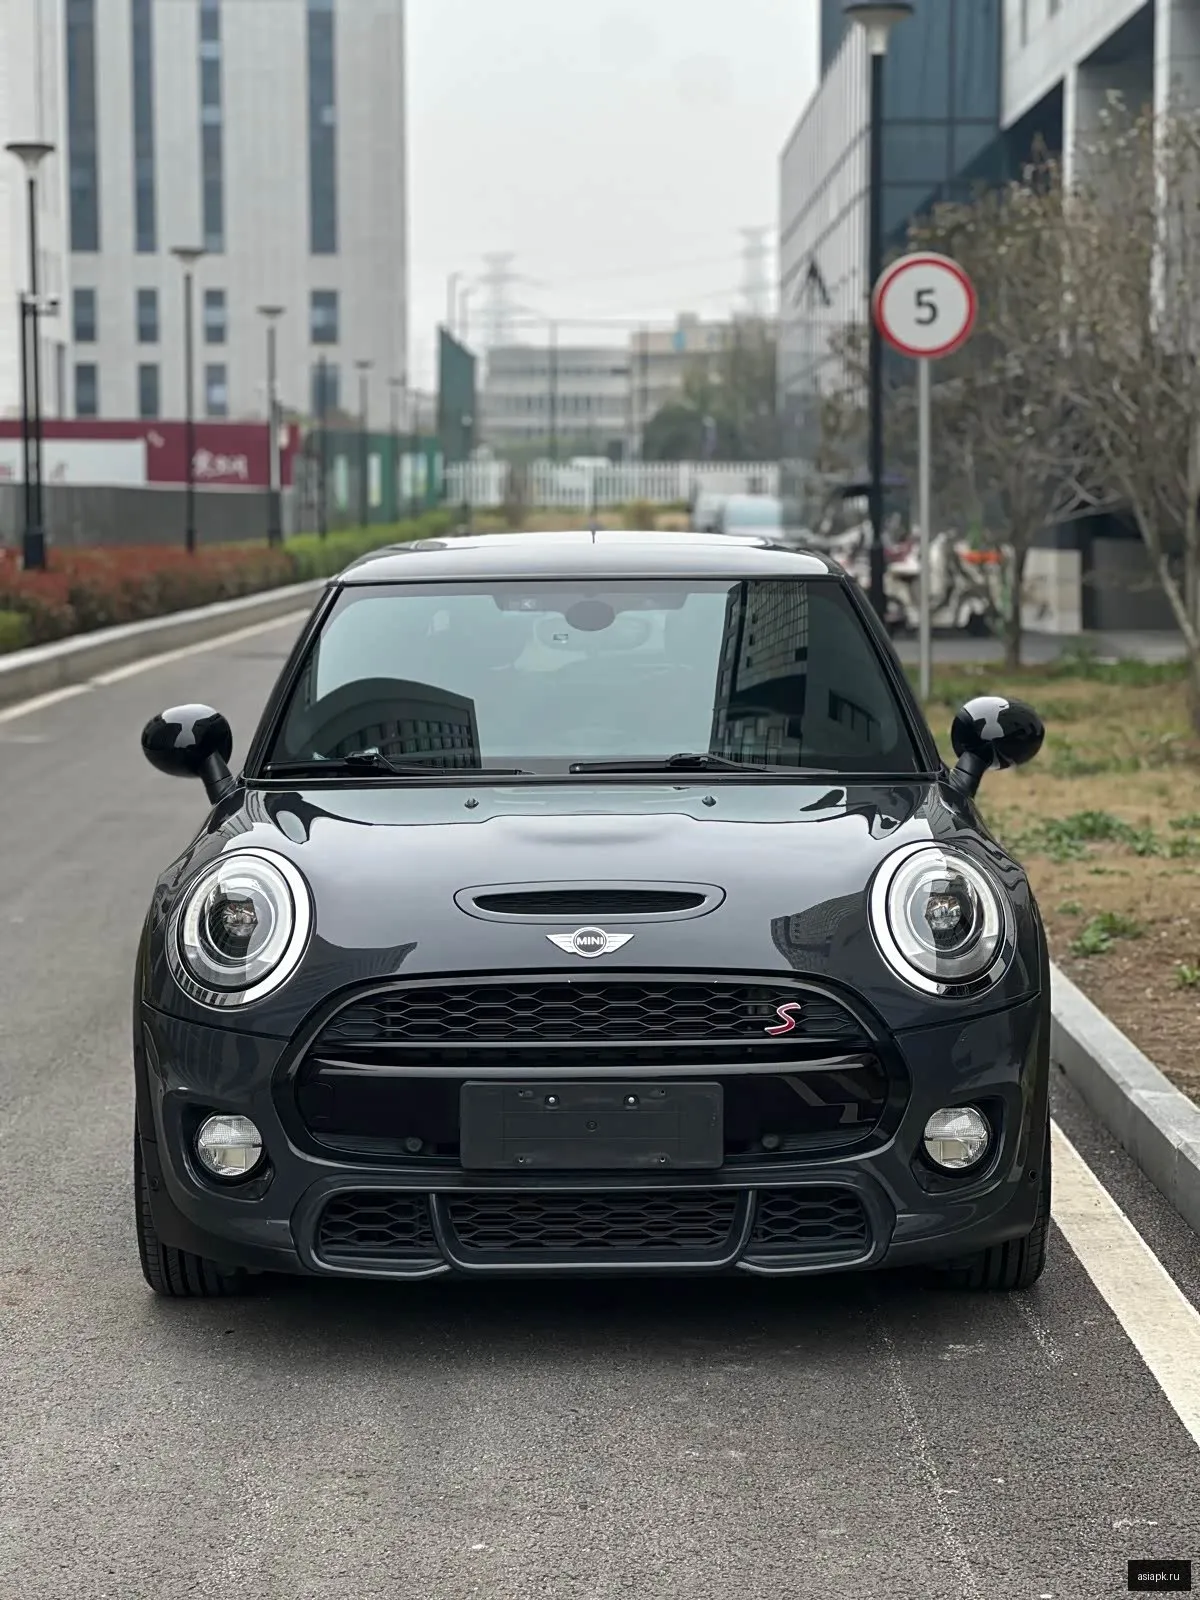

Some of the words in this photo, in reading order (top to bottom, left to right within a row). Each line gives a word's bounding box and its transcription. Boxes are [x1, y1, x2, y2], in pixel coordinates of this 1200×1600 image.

[915, 288, 938, 326] 5
[576, 936, 604, 946] MINI
[764, 1002, 802, 1036] S
